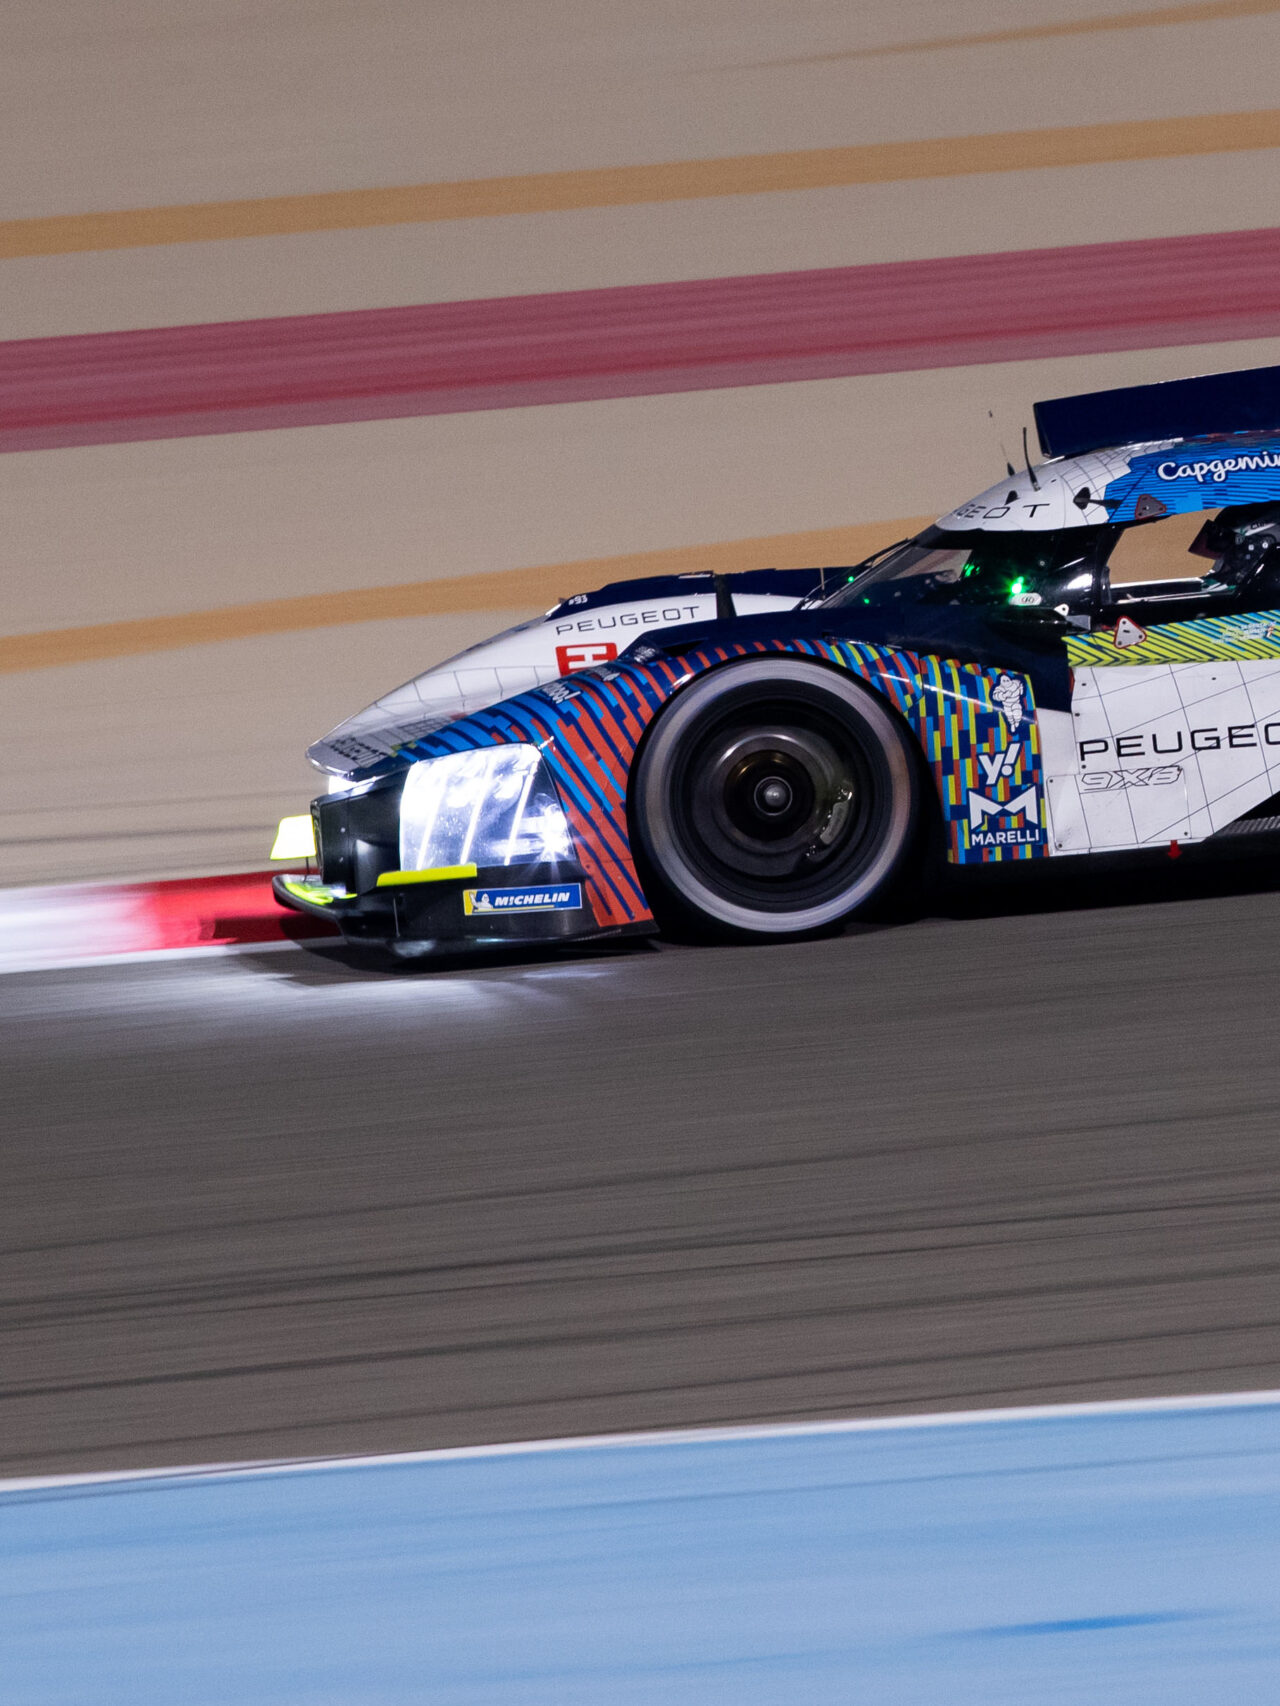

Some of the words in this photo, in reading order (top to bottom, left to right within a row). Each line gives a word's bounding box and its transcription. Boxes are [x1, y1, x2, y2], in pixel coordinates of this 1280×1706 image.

[555, 606, 700, 636] PEUGEOT
[1081, 765, 1183, 791] 9X8
[971, 829, 1040, 846] MARELLI
[494, 892, 571, 907] MICHELIN
